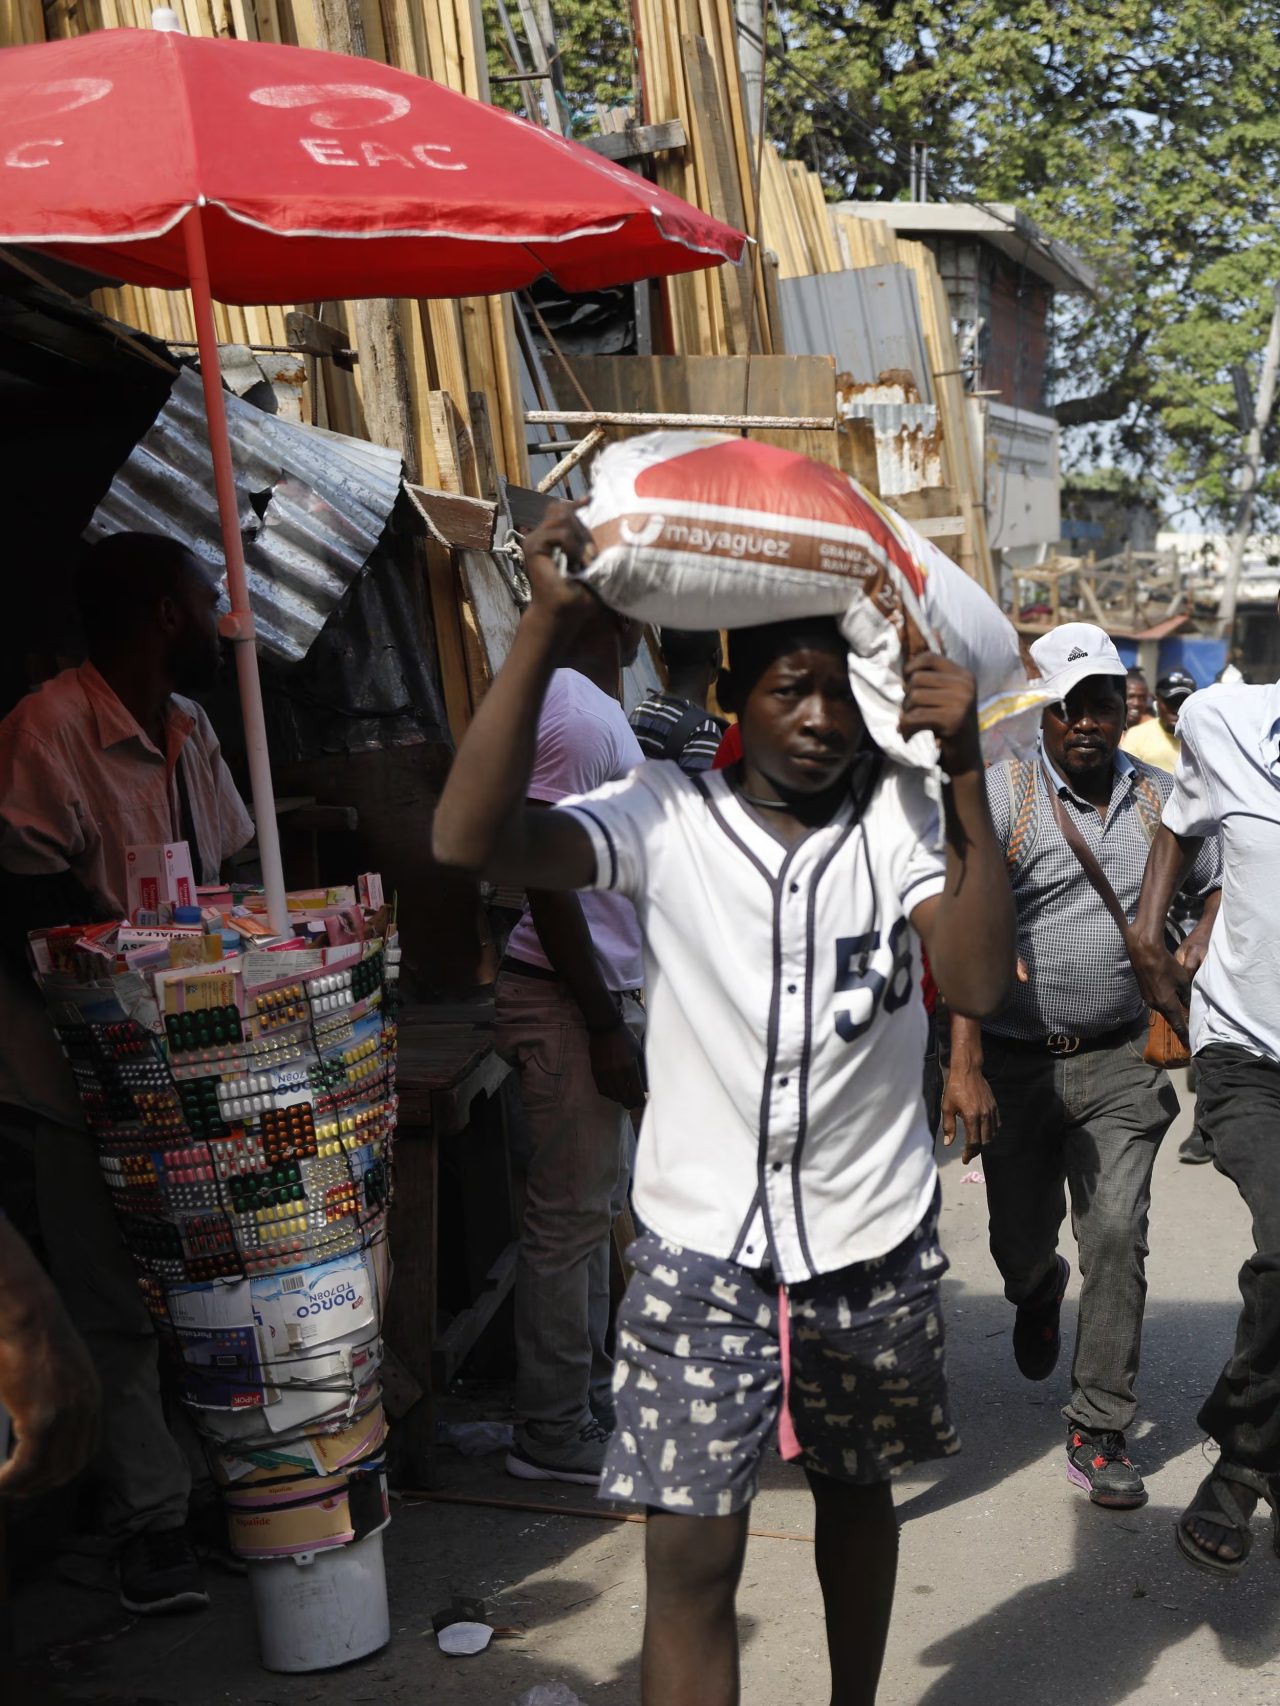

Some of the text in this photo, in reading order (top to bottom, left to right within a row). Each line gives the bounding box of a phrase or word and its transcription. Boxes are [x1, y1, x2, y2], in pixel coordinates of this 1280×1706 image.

[300, 138, 469, 172] EAC
[665, 525, 791, 559] mayaguez
[1067, 651, 1088, 662] adidas
[296, 1288, 356, 1319] DORCO
[308, 1281, 353, 1303] TD708N
